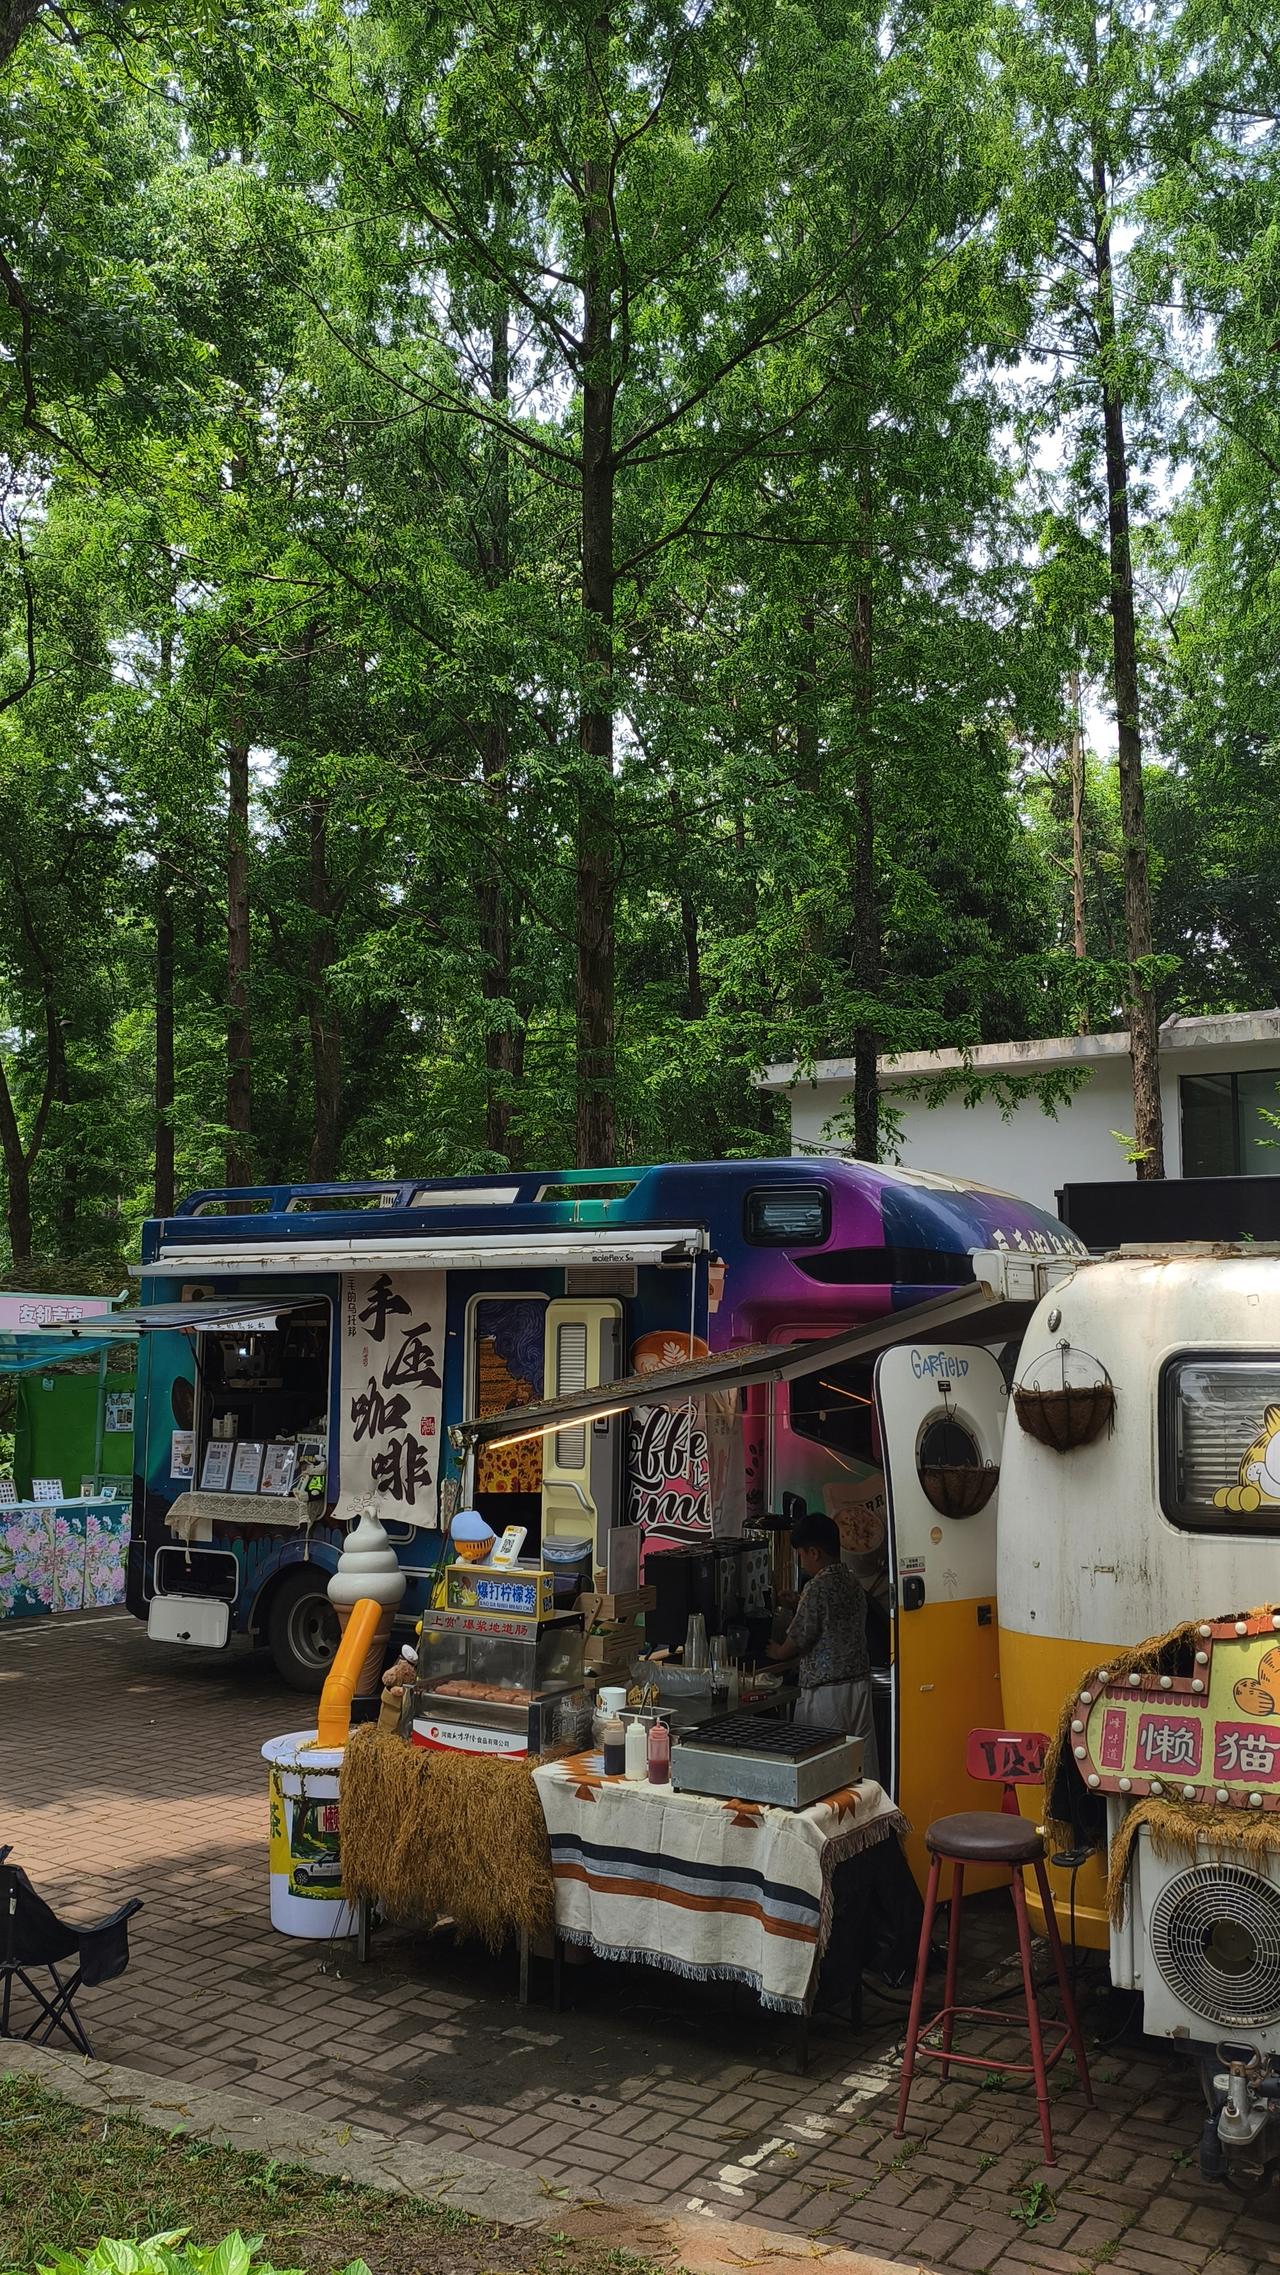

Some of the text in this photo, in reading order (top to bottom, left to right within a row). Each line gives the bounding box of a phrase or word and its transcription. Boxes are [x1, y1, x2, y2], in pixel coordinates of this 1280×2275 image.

[477, 1580, 536, 1606] 爆打柠檬茶
